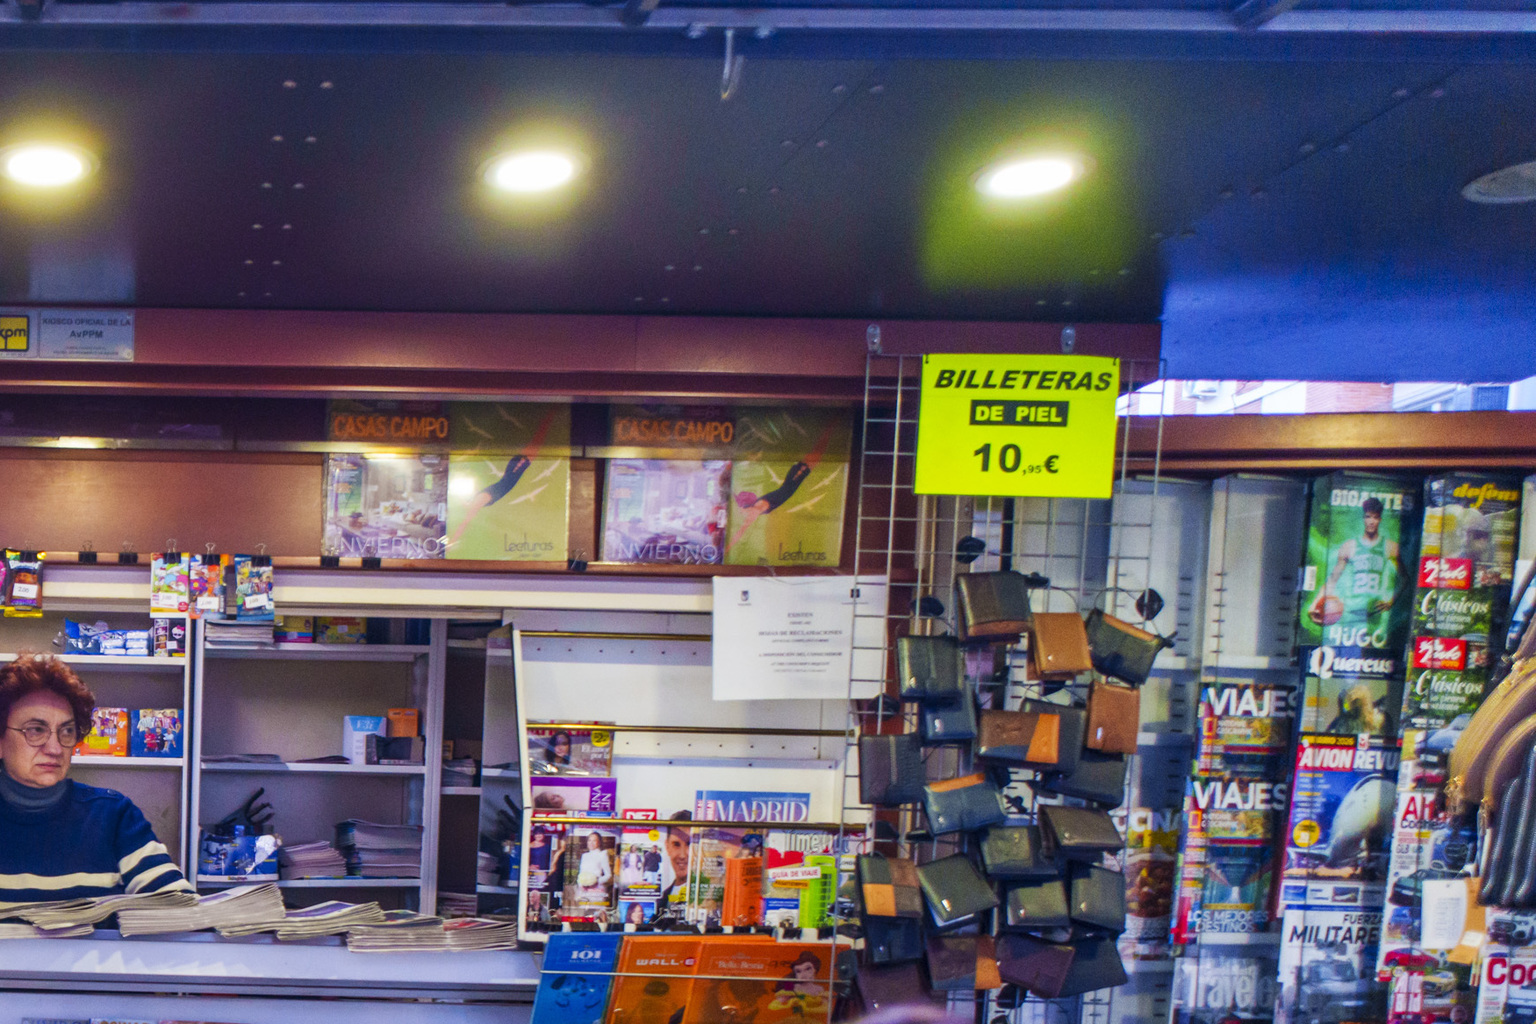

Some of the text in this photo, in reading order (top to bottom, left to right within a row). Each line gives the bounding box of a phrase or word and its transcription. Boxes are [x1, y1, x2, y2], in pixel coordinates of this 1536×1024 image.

[933, 369, 1113, 393] BILLETERAS
[975, 404, 1063, 424] DE PIEL
[333, 415, 448, 439] CASAS CAMPO
[617, 418, 734, 444] CASAS CAMPO
[332, 536, 441, 557] INVIERNO
[610, 543, 718, 563] INVIERNO
[1421, 590, 1489, 616] Clásicos
[1309, 645, 1394, 679] Quercus
[1415, 670, 1484, 696] Clásicos
[1207, 687, 1296, 717] VIAJES
[1298, 748, 1353, 769] AVION
[1192, 781, 1287, 811] VIAJES
[715, 800, 808, 822] MADRID
[570, 949, 602, 960] 101
